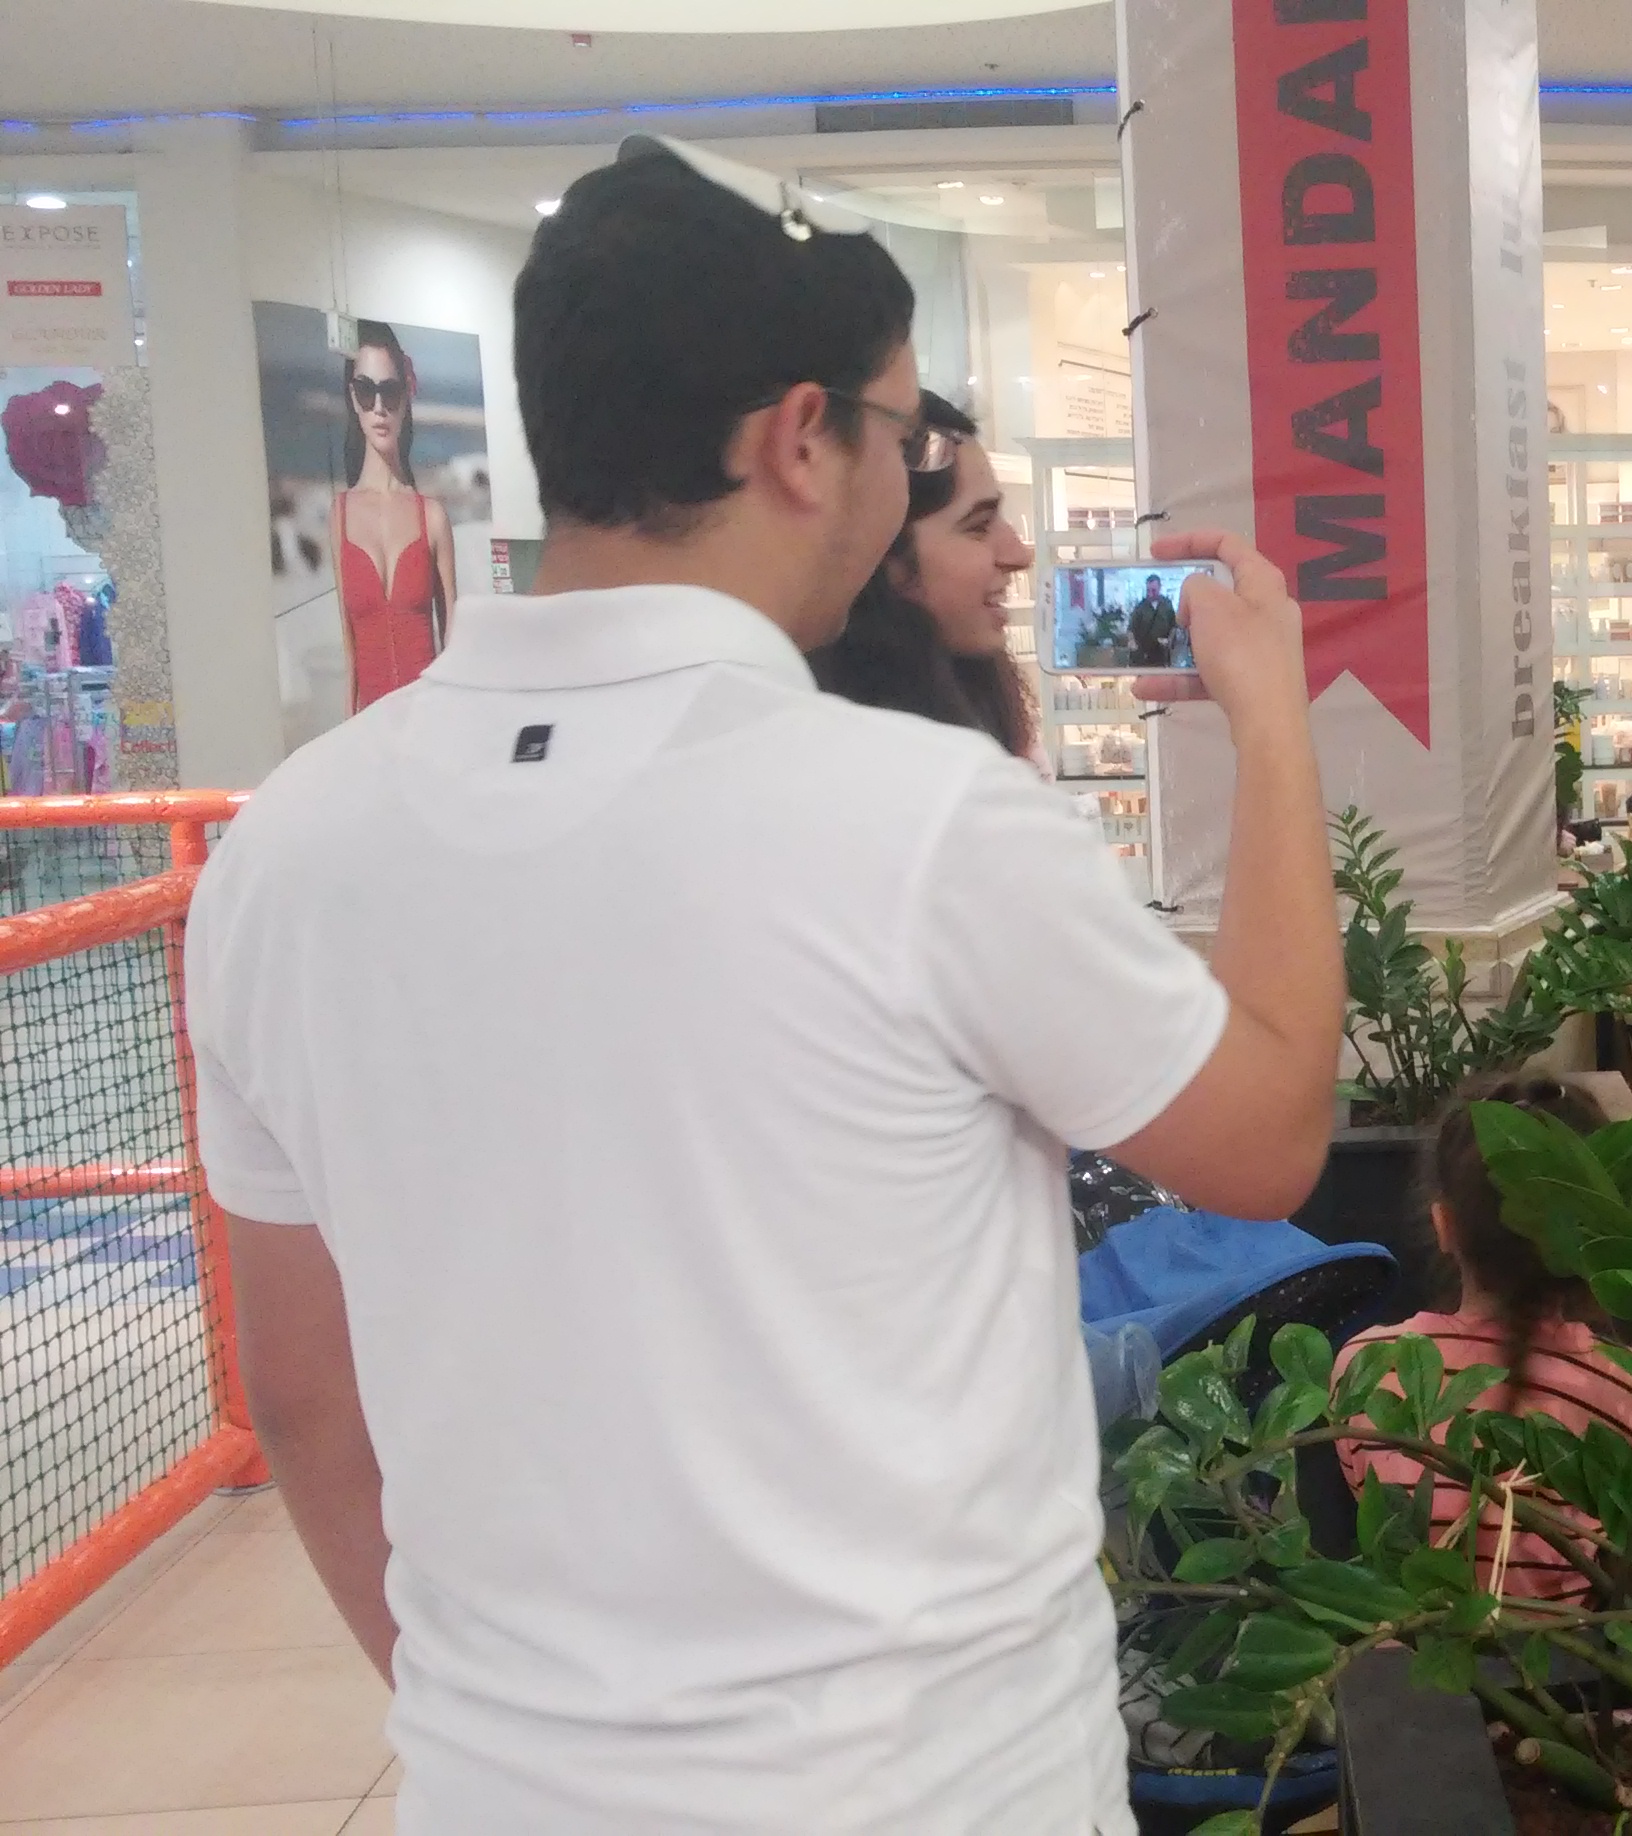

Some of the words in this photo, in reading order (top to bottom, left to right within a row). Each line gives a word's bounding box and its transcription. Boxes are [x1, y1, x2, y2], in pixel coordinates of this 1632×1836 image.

[2, 225, 100, 242] EXPOSE
[64, 284, 92, 294] LADY
[1273, 0, 1389, 602] MANDA
